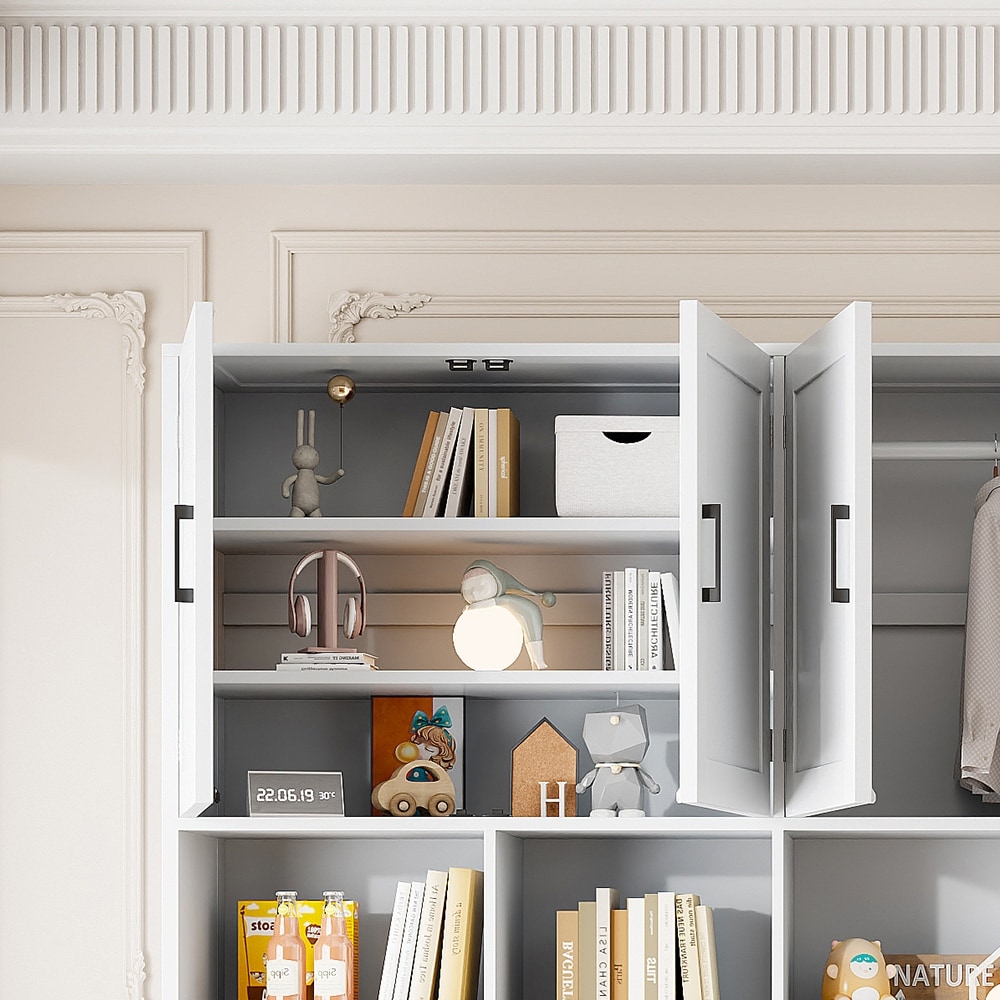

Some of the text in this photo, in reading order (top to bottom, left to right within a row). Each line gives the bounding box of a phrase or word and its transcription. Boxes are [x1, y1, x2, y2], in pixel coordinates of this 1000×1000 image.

[440, 441, 450, 468] sustainable
[257, 788, 314, 802] 22.06.19
[893, 963, 994, 987] NATURE
